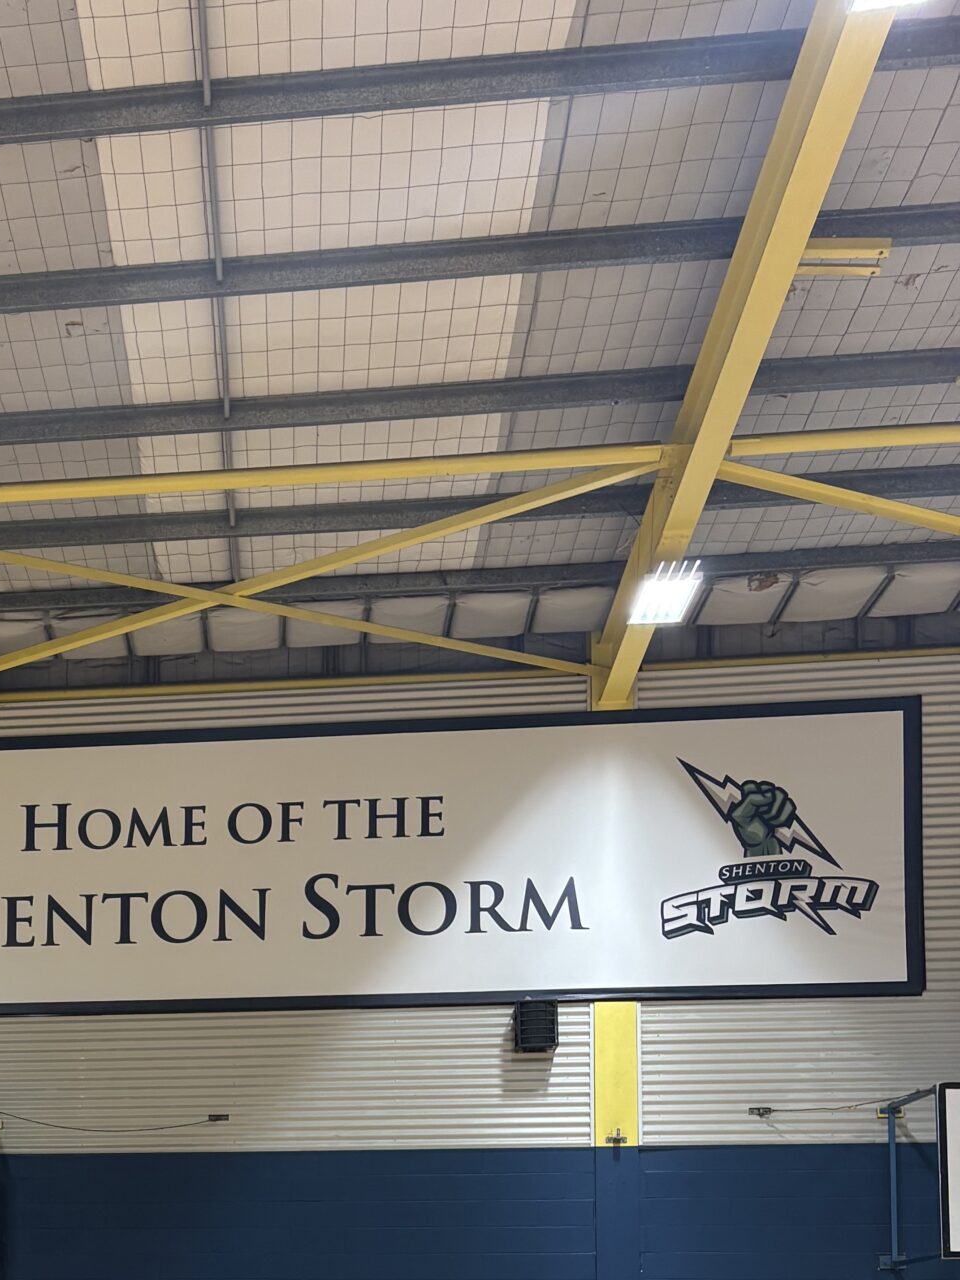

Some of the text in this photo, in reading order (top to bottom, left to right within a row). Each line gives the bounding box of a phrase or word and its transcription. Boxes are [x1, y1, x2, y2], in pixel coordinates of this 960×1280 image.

[20, 795, 446, 852] HOME OF THE
[721, 861, 804, 879] SHENTON
[302, 873, 590, 940] STORM
[661, 877, 879, 940] STORM
